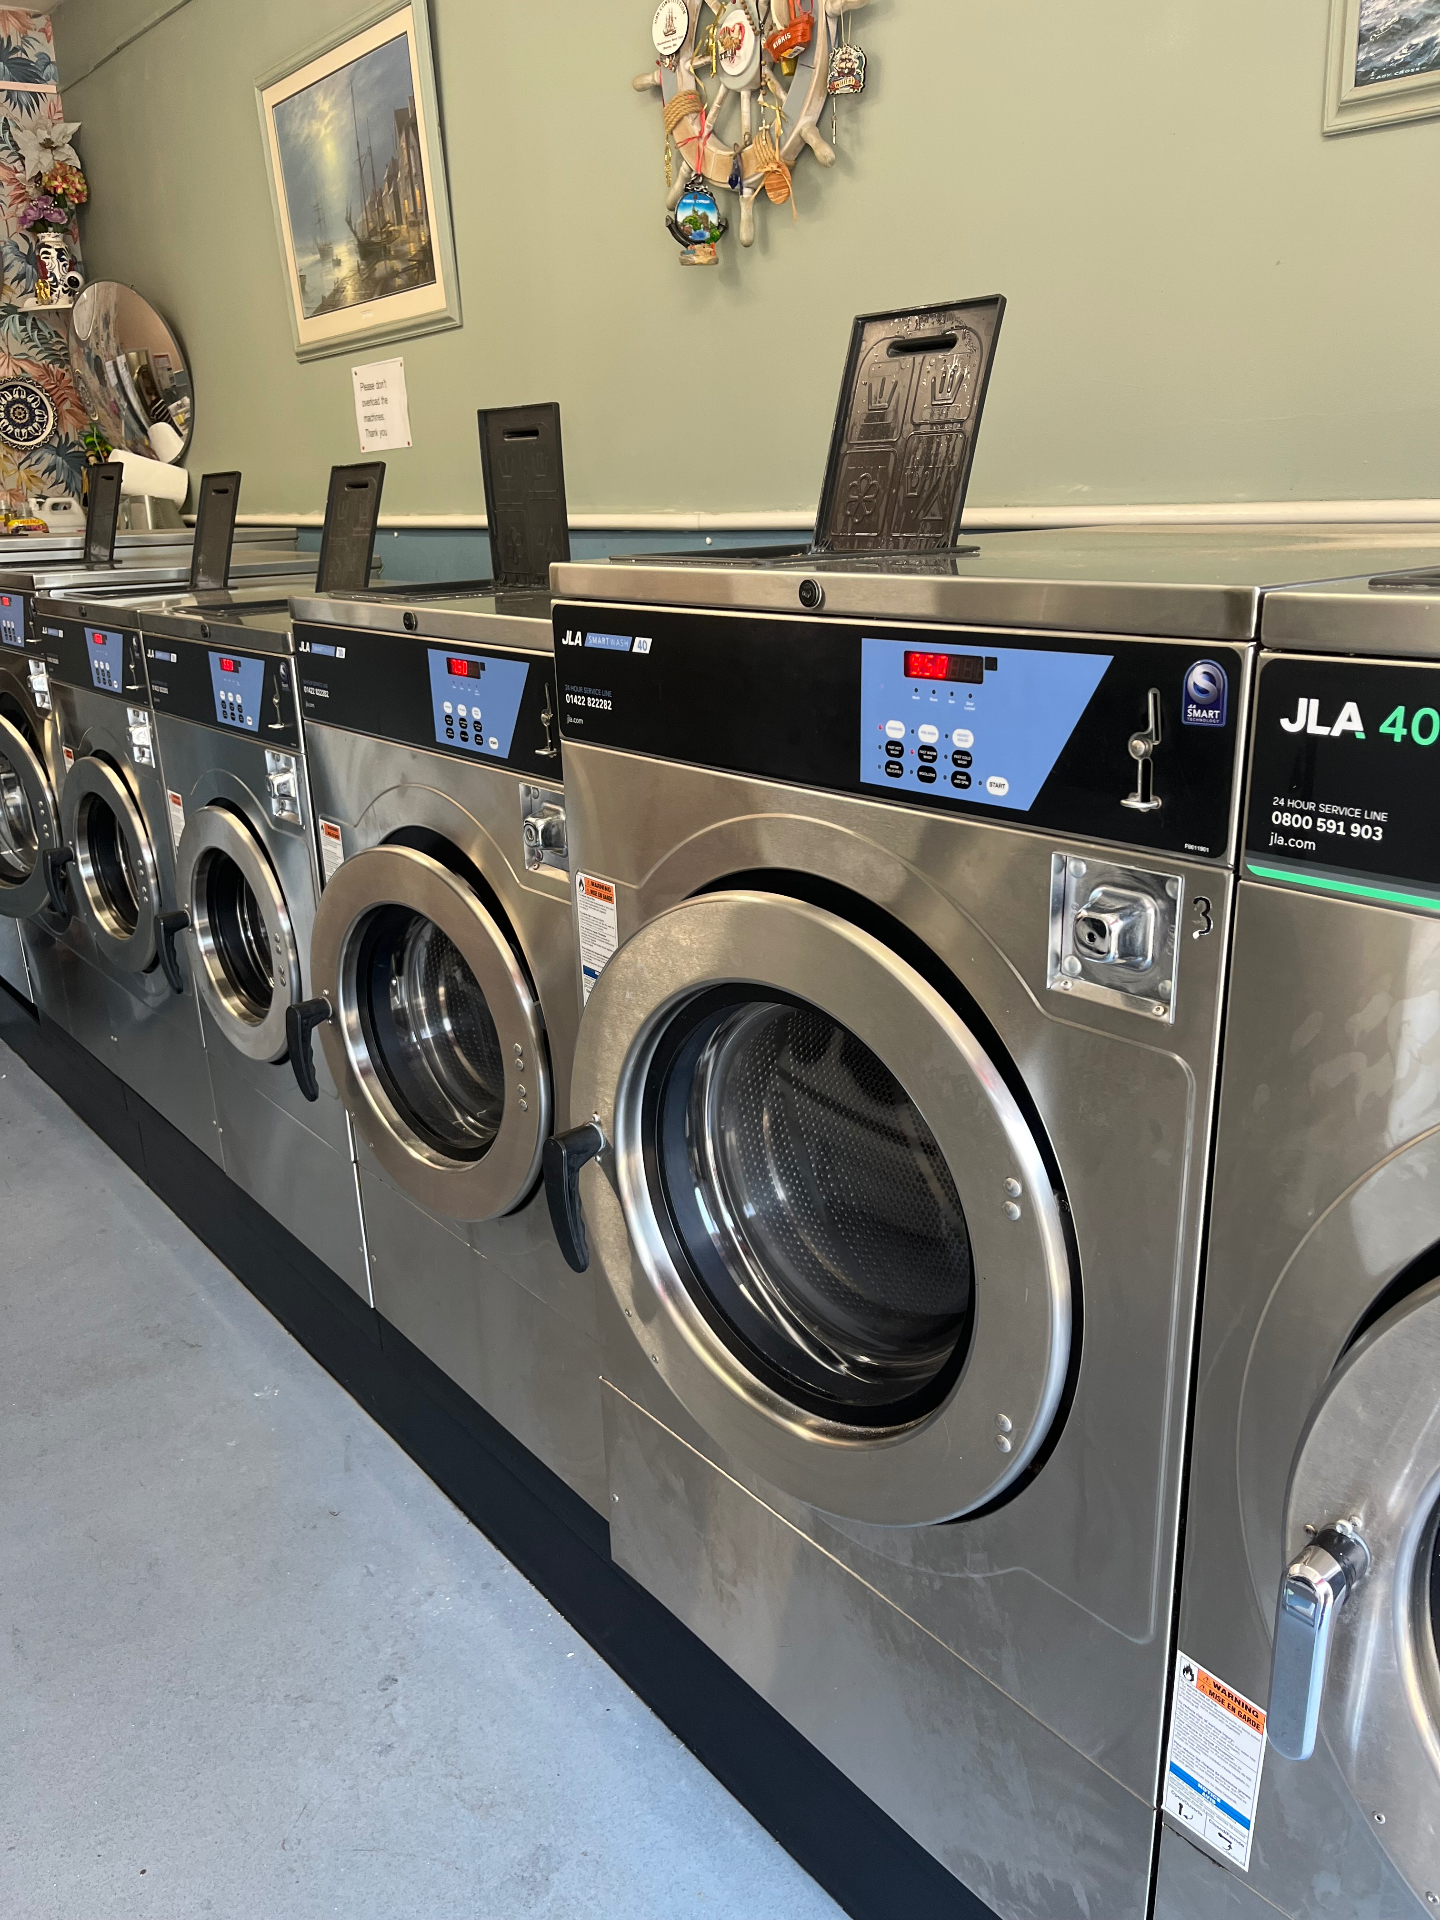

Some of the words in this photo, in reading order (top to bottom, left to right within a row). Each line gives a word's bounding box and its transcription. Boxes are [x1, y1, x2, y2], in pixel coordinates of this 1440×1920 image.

[562, 630, 582, 647] JLA
[637, 640, 648, 652] 40
[565, 693, 586, 706] 01422
[587, 696, 612, 710] 822282
[1187, 709, 1220, 719] SMART
[1279, 698, 1366, 739] JLA
[1379, 705, 1440, 746] 40
[989, 781, 1006, 790] START
[1272, 796, 1285, 806] 24
[1287, 798, 1316, 811] HOUR
[1318, 803, 1362, 818] SERVICE
[1364, 810, 1389, 822] LINE
[1271, 811, 1313, 830] 0800
[1316, 817, 1346, 836] 591
[1350, 823, 1384, 841] 903
[1268, 832, 1316, 851] jla.com
[1193, 896, 1214, 940] 3
[1208, 1690, 1225, 1706] MISE
[1227, 1704, 1236, 1714] EN
[1237, 1710, 1261, 1731] GARDE
[1212, 1681, 1259, 1719] WARNING
[1197, 1782, 1222, 1803] NOTICE
